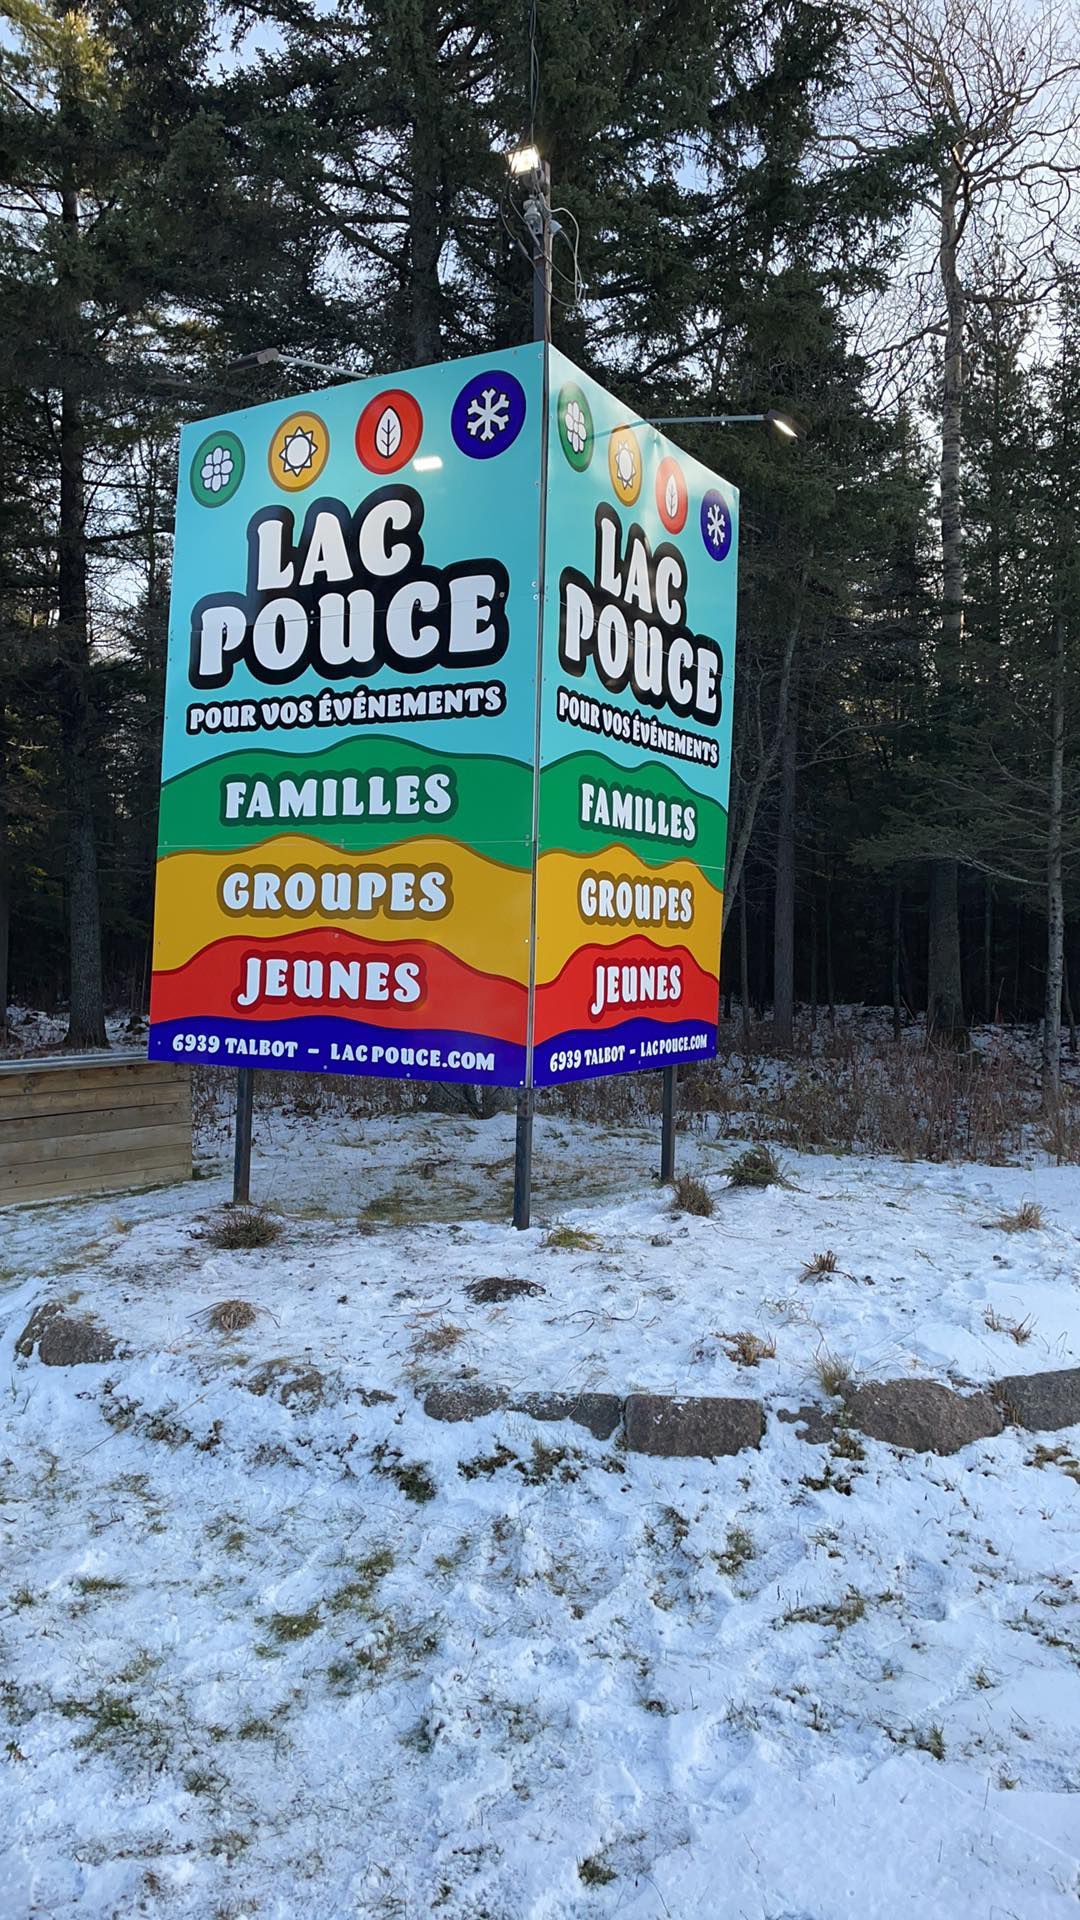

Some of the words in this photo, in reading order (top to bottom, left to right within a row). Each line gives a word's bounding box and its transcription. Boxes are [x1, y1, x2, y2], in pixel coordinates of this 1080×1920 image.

[257, 499, 413, 591] LAC
[600, 517, 683, 626] LAC
[198, 574, 496, 676] POUCE
[564, 582, 719, 714] POUCE
[190, 704, 257, 730] POUR
[261, 700, 314, 725] VOS
[318, 686, 502, 722] ÉVÉNEMENTS
[558, 691, 601, 729] POUR
[602, 708, 632, 740] VOS
[632, 714, 719, 764] ÉVÉNEMENTS
[225, 773, 451, 819] FAMILLES
[581, 783, 696, 841] FAMILLES
[222, 871, 447, 913] GROUPES
[580, 877, 692, 923] GROUPES
[237, 957, 421, 1006] JEUNES
[591, 965, 682, 1015] JEUNES
[172, 1033, 220, 1054] 6939
[224, 1037, 299, 1058] TALBOT
[330, 1043, 495, 1071] LACPOUCE.COM
[549, 1049, 582, 1073] 6939
[583, 1045, 626, 1066] TALBOT
[640, 1033, 708, 1057] LACPOUCE.COM
